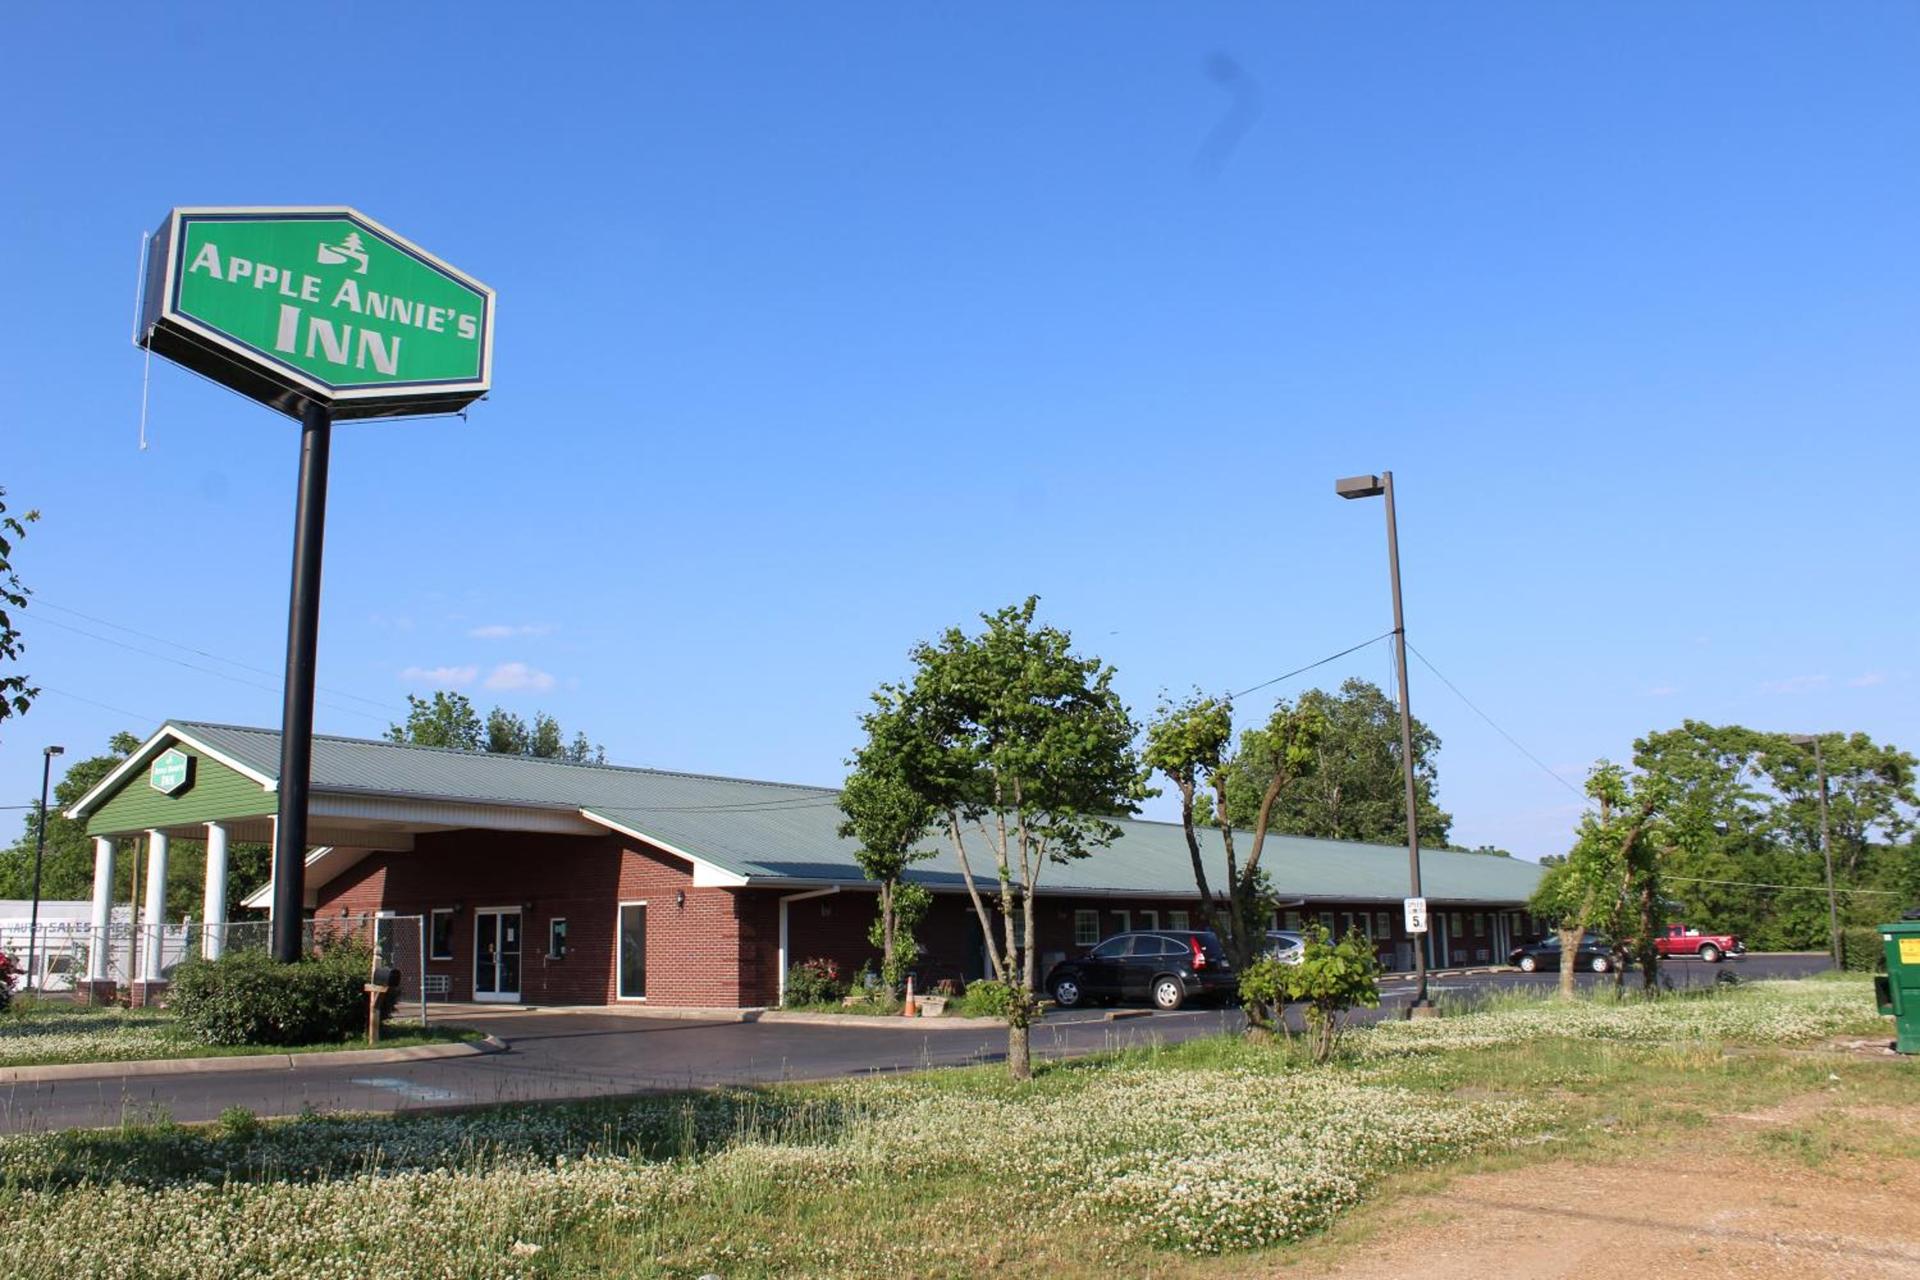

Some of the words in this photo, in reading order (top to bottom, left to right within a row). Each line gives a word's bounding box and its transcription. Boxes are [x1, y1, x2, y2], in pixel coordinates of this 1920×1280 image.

[188, 242, 321, 303] APPLE
[331, 277, 478, 340] ANNIE'S
[274, 303, 402, 376] INN
